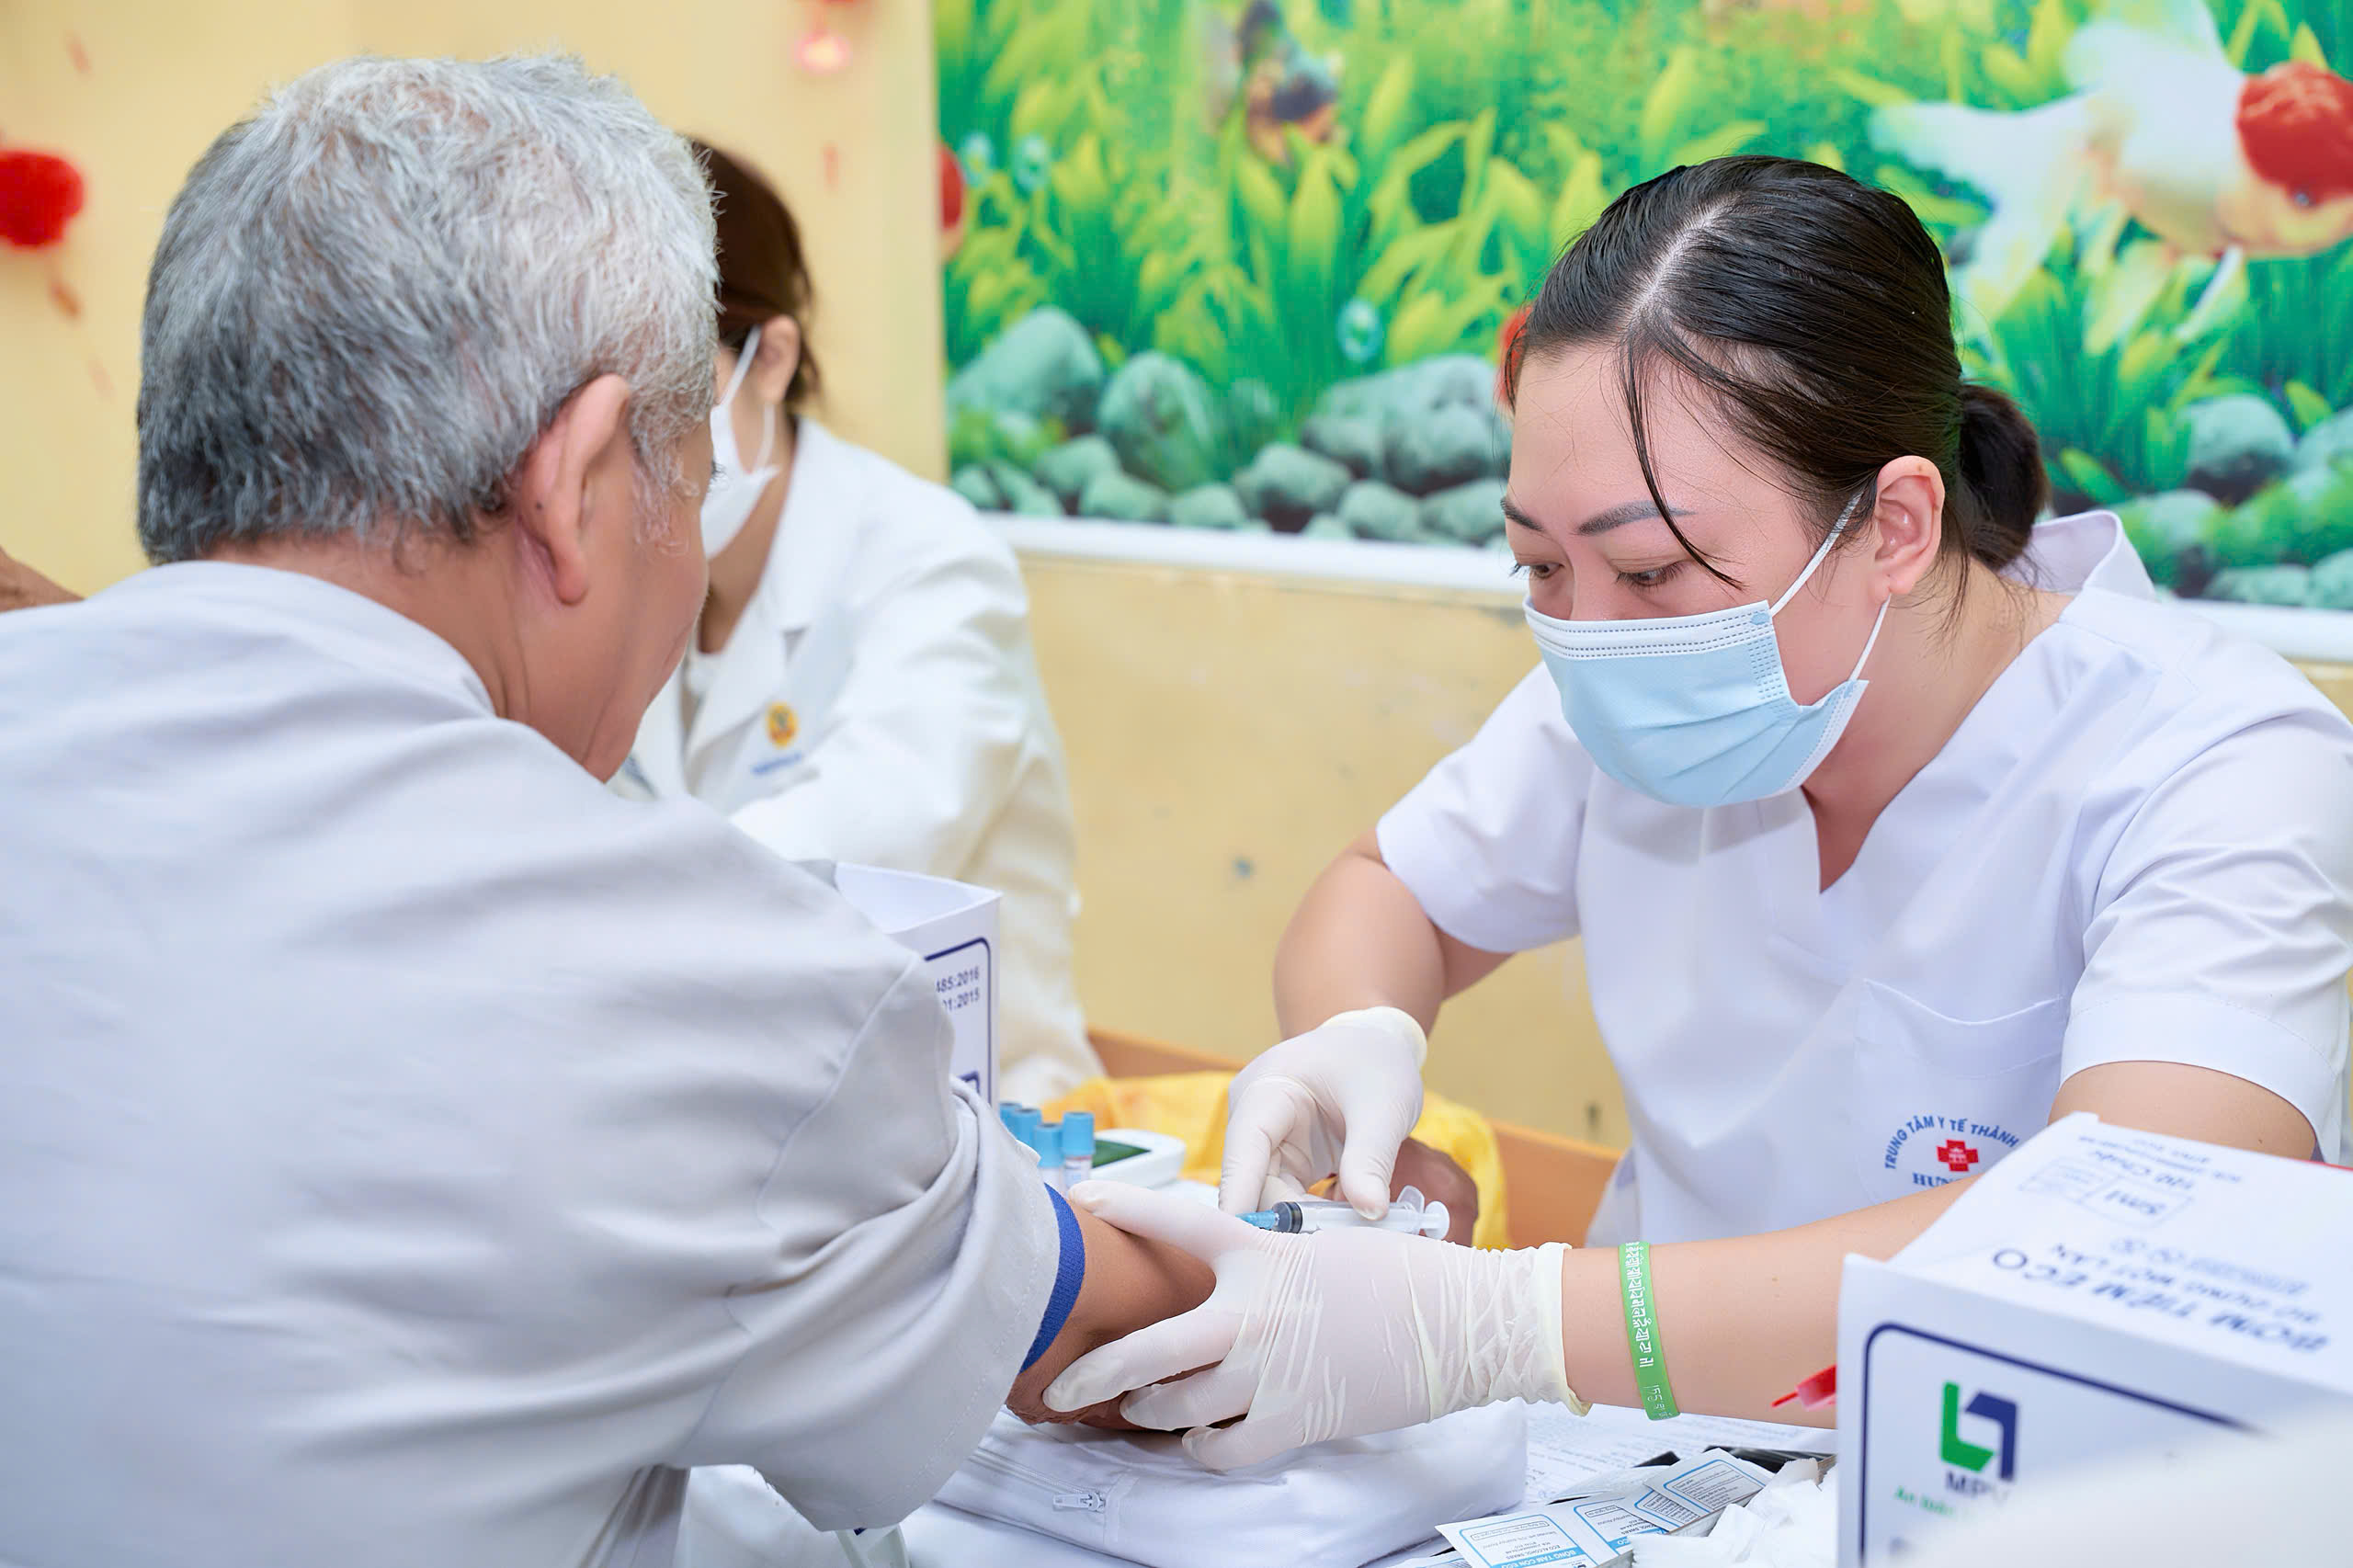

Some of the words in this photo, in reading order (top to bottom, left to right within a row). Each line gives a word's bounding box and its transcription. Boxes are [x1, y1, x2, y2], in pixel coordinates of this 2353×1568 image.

[1885, 1129, 1908, 1169] TRUNG
[1906, 1106, 1934, 1133] TÂM
[1938, 1116, 1945, 1129] Y
[1949, 1119, 1968, 1131] TẾ
[1971, 1125, 2020, 1148] THÀNH
[1993, 1248, 2089, 1287] ECO
